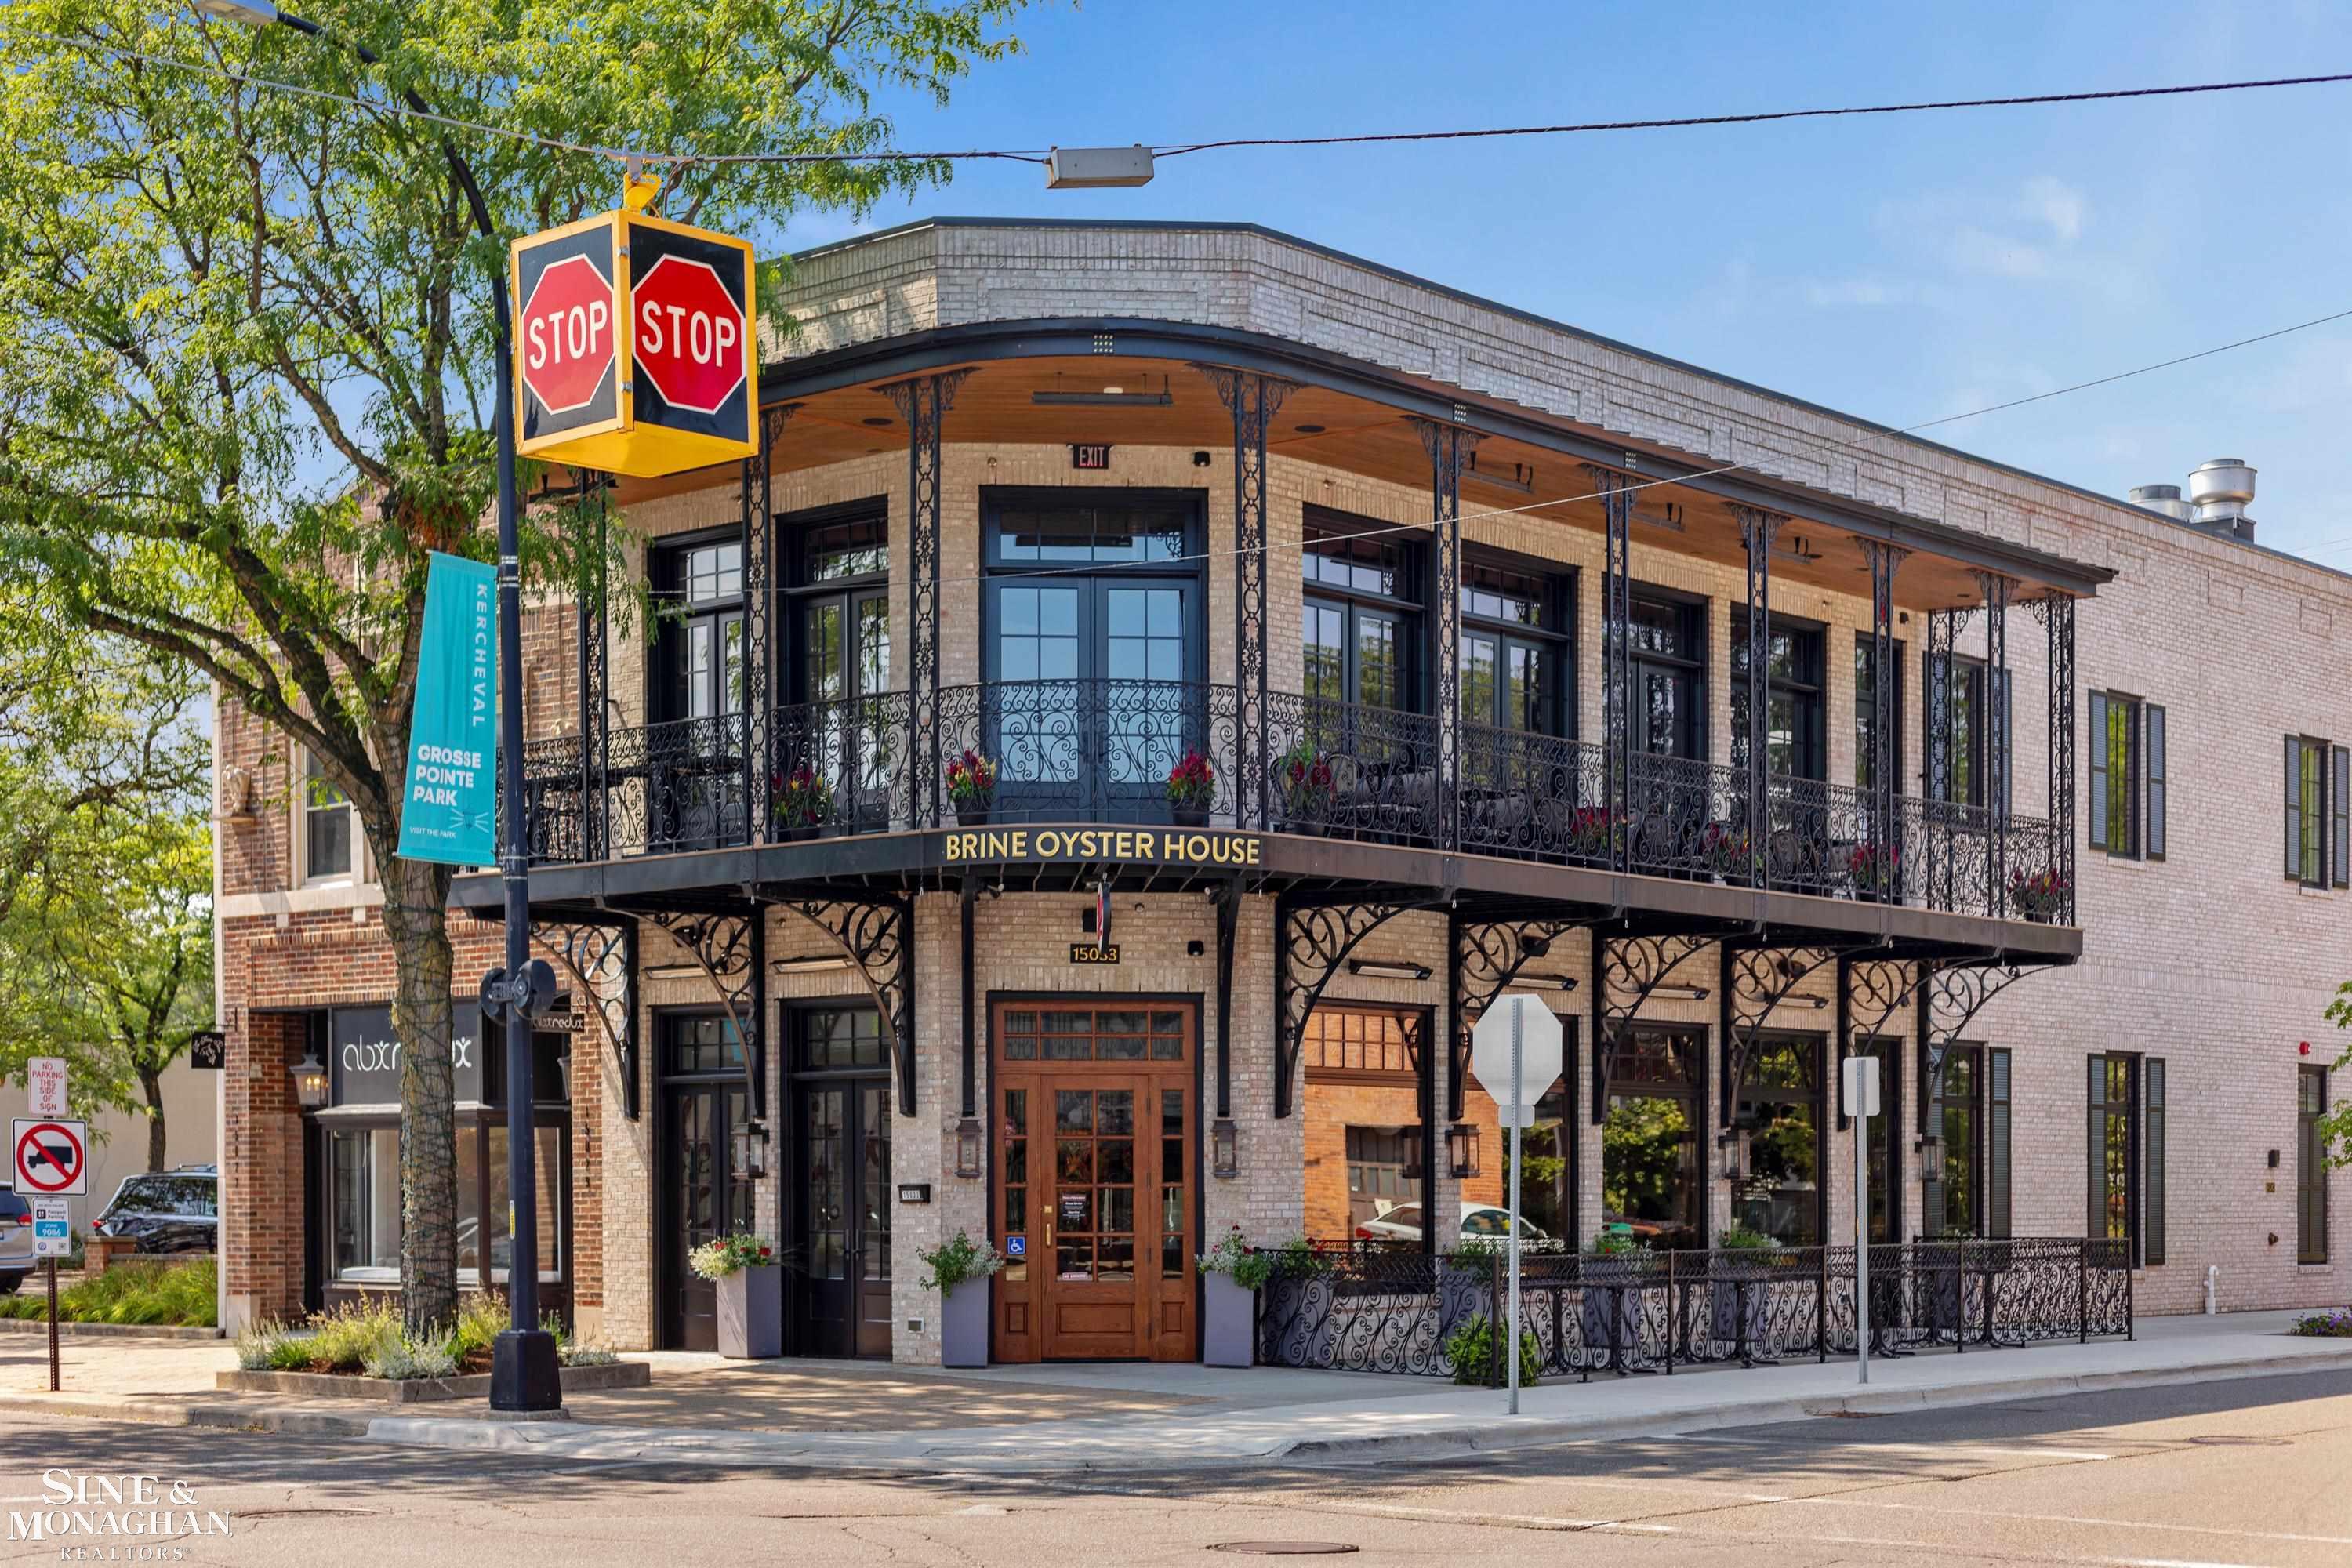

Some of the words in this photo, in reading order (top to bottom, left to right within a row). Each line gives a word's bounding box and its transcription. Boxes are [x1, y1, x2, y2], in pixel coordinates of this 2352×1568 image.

[529, 300, 608, 370] STOP
[641, 300, 736, 368] STOP
[1079, 446, 1105, 467] EXIT
[473, 583, 488, 727] KERCHEVAL
[417, 744, 481, 769] GROSSE
[415, 764, 474, 788] POINTE
[412, 784, 458, 806] PARK
[409, 826, 426, 835] VISIT
[439, 829, 456, 839] PARK
[946, 831, 1028, 861] BRINE
[1036, 831, 1155, 859] OYSTER
[1164, 833, 1261, 865] HOUSE
[32, 1070, 63, 1079] PARKING
[42, 1062, 53, 1071] NO
[40, 1079, 56, 1087] THIS
[39, 1103, 56, 1112] SIGN
